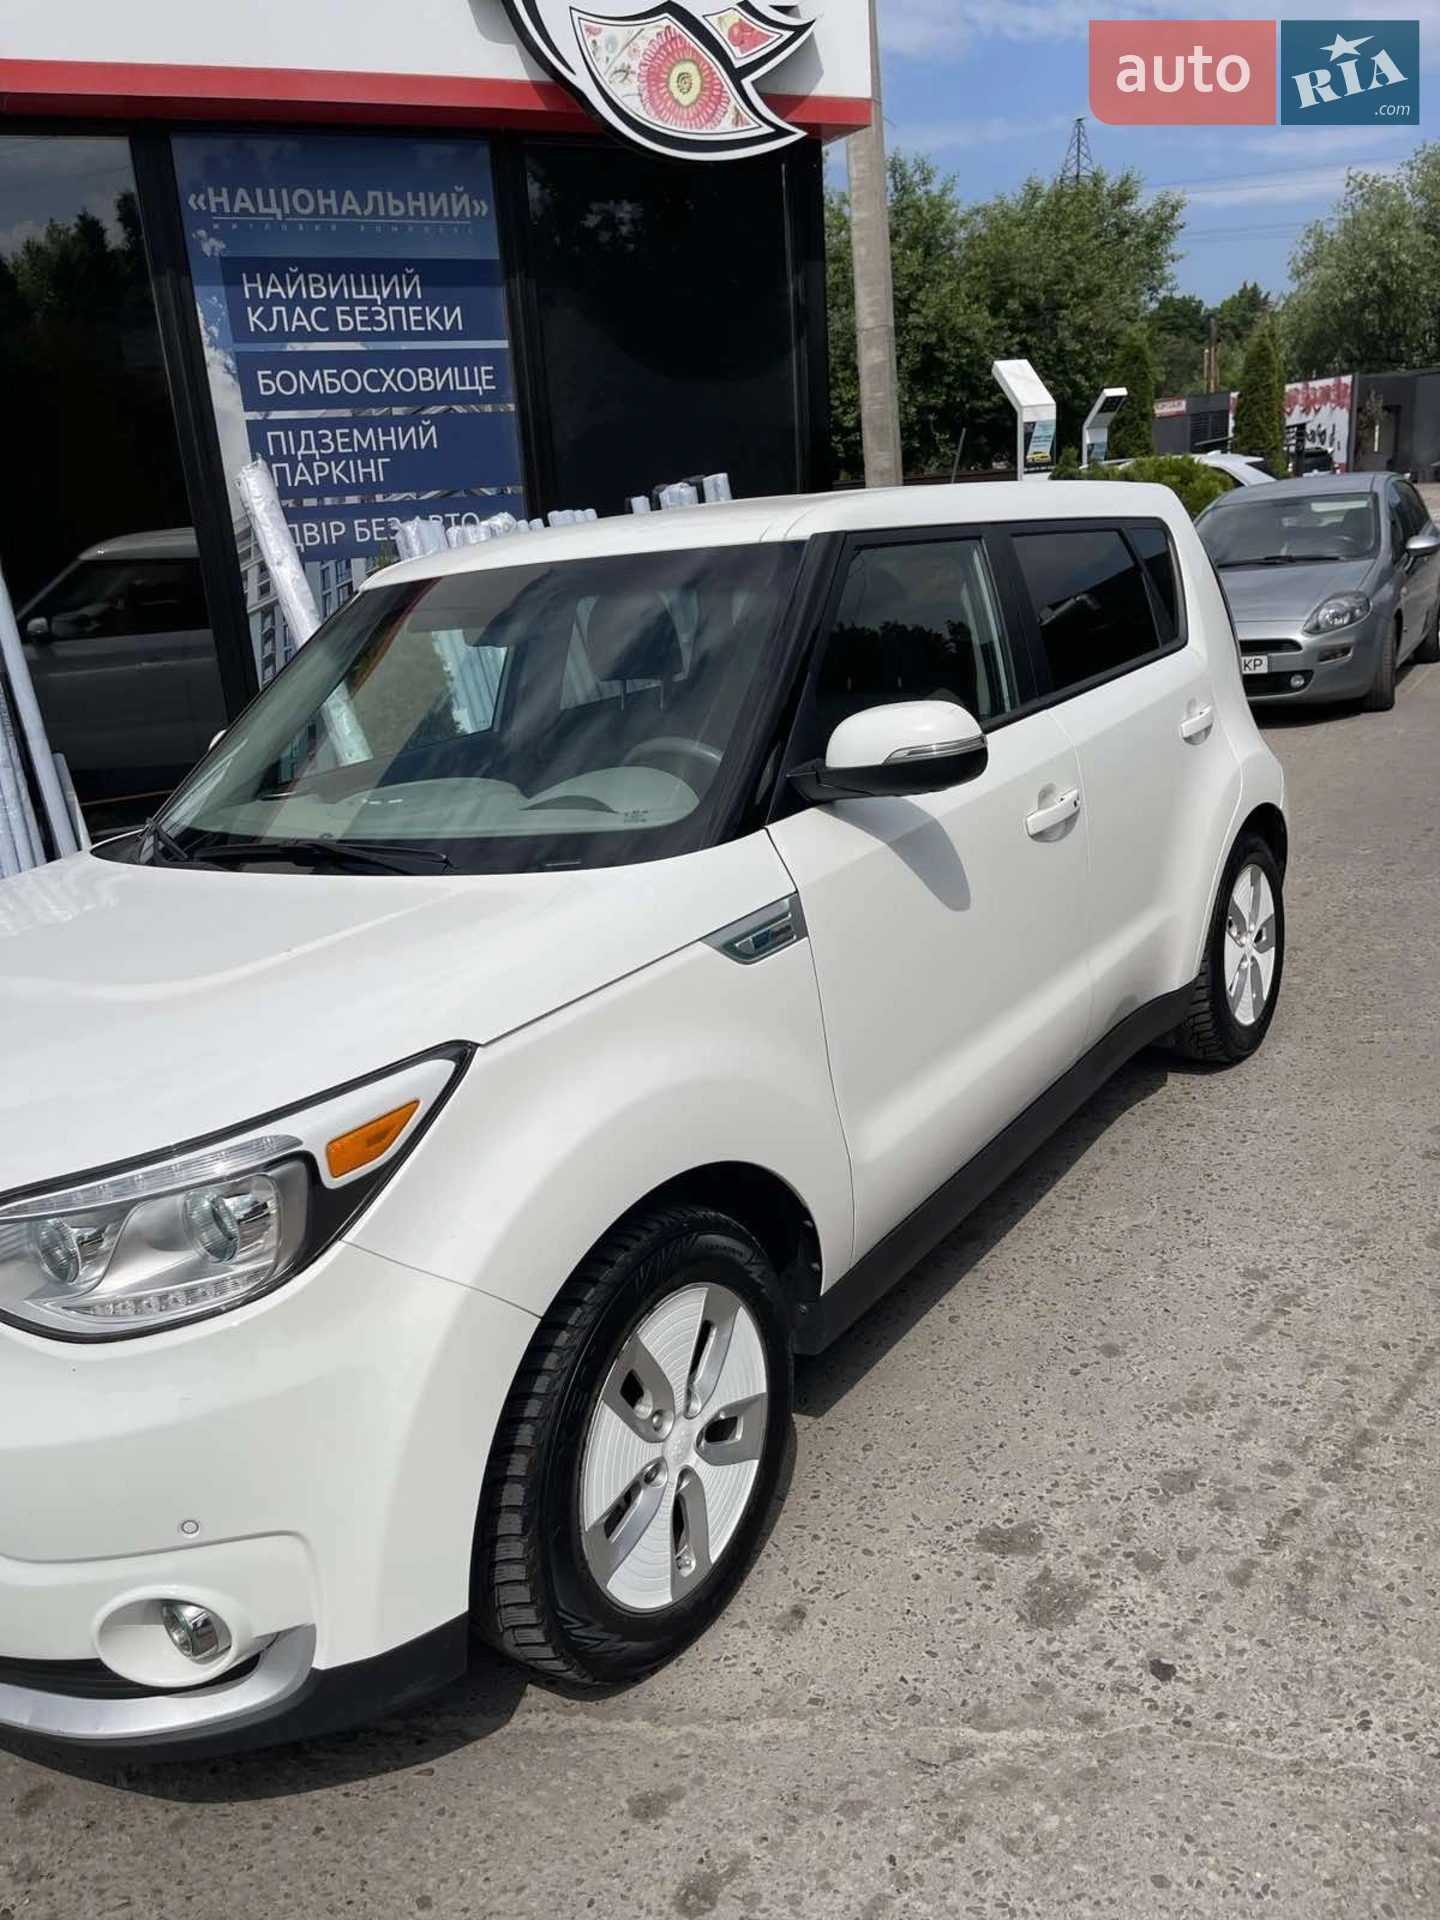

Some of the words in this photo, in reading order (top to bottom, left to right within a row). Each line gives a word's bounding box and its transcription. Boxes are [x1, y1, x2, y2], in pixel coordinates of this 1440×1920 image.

[187, 185, 489, 220] «НАЦІОНАЛЬНИЙ»
[242, 267, 423, 304] НАЙВИЩИЙ
[247, 306, 330, 333] КЛАС
[336, 306, 463, 332] БЕЗПЕКИ
[257, 366, 497, 395] БОМБОСХОВИЩЕ
[266, 421, 438, 460] ПІДЗЕМНИЙ
[271, 458, 391, 487] ПАРКІНГ
